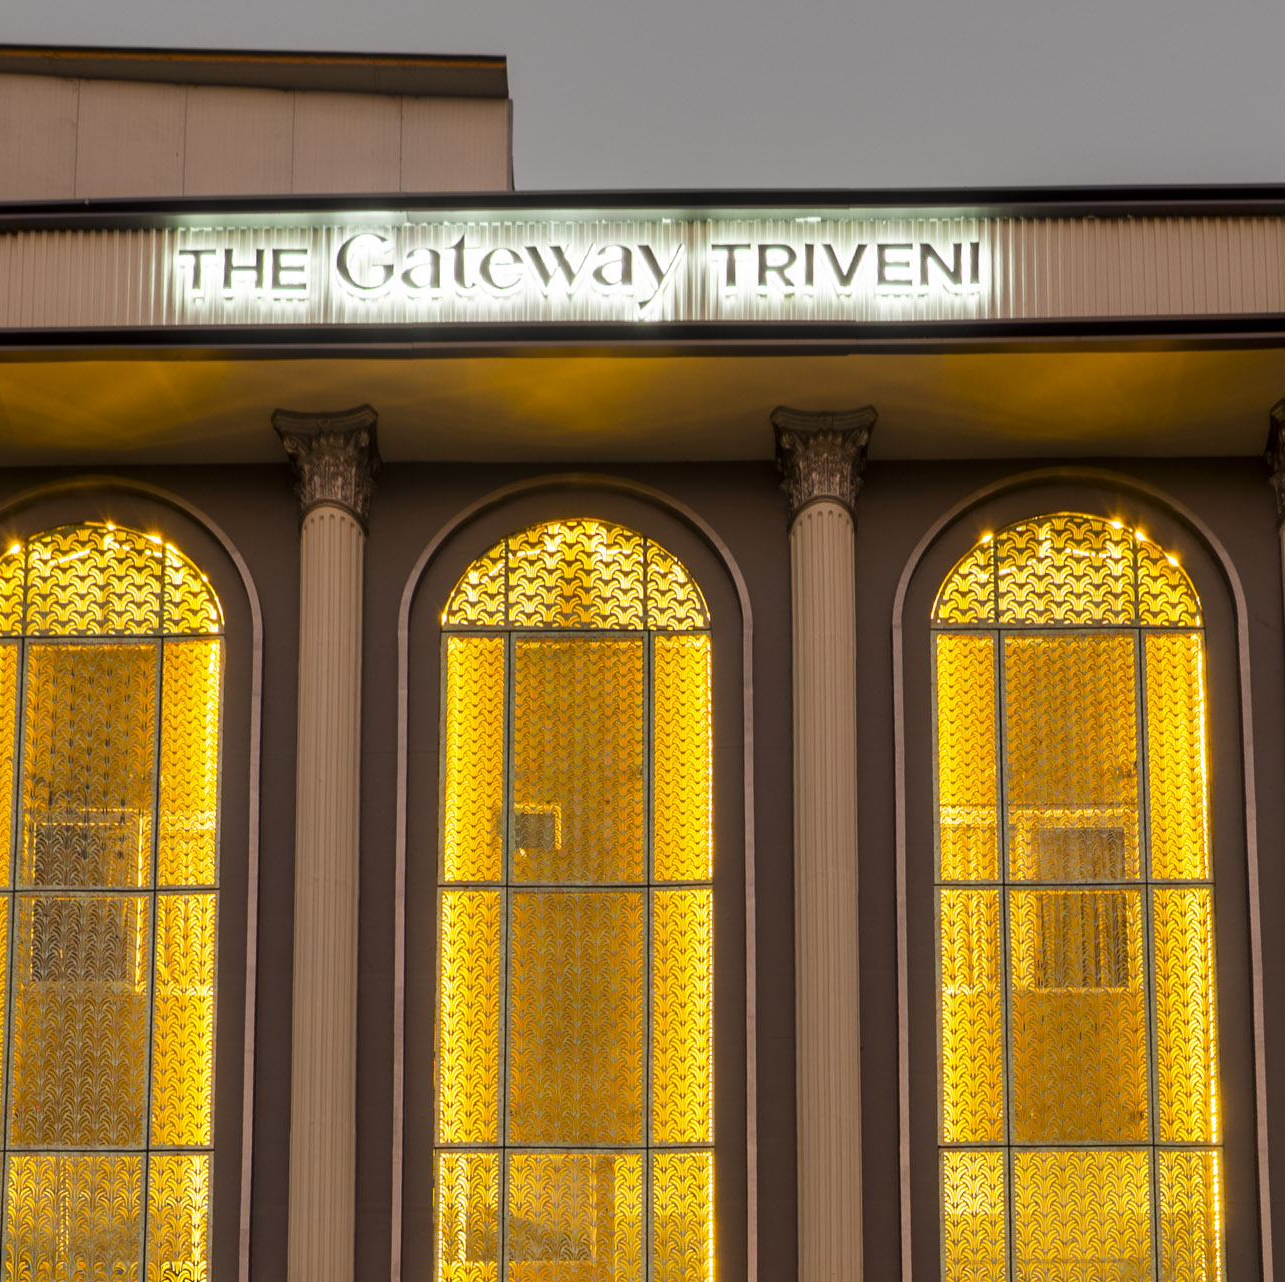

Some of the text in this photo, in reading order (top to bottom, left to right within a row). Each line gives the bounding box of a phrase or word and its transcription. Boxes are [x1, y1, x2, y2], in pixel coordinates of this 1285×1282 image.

[179, 232, 983, 312] THE Gateway TRIVENI
